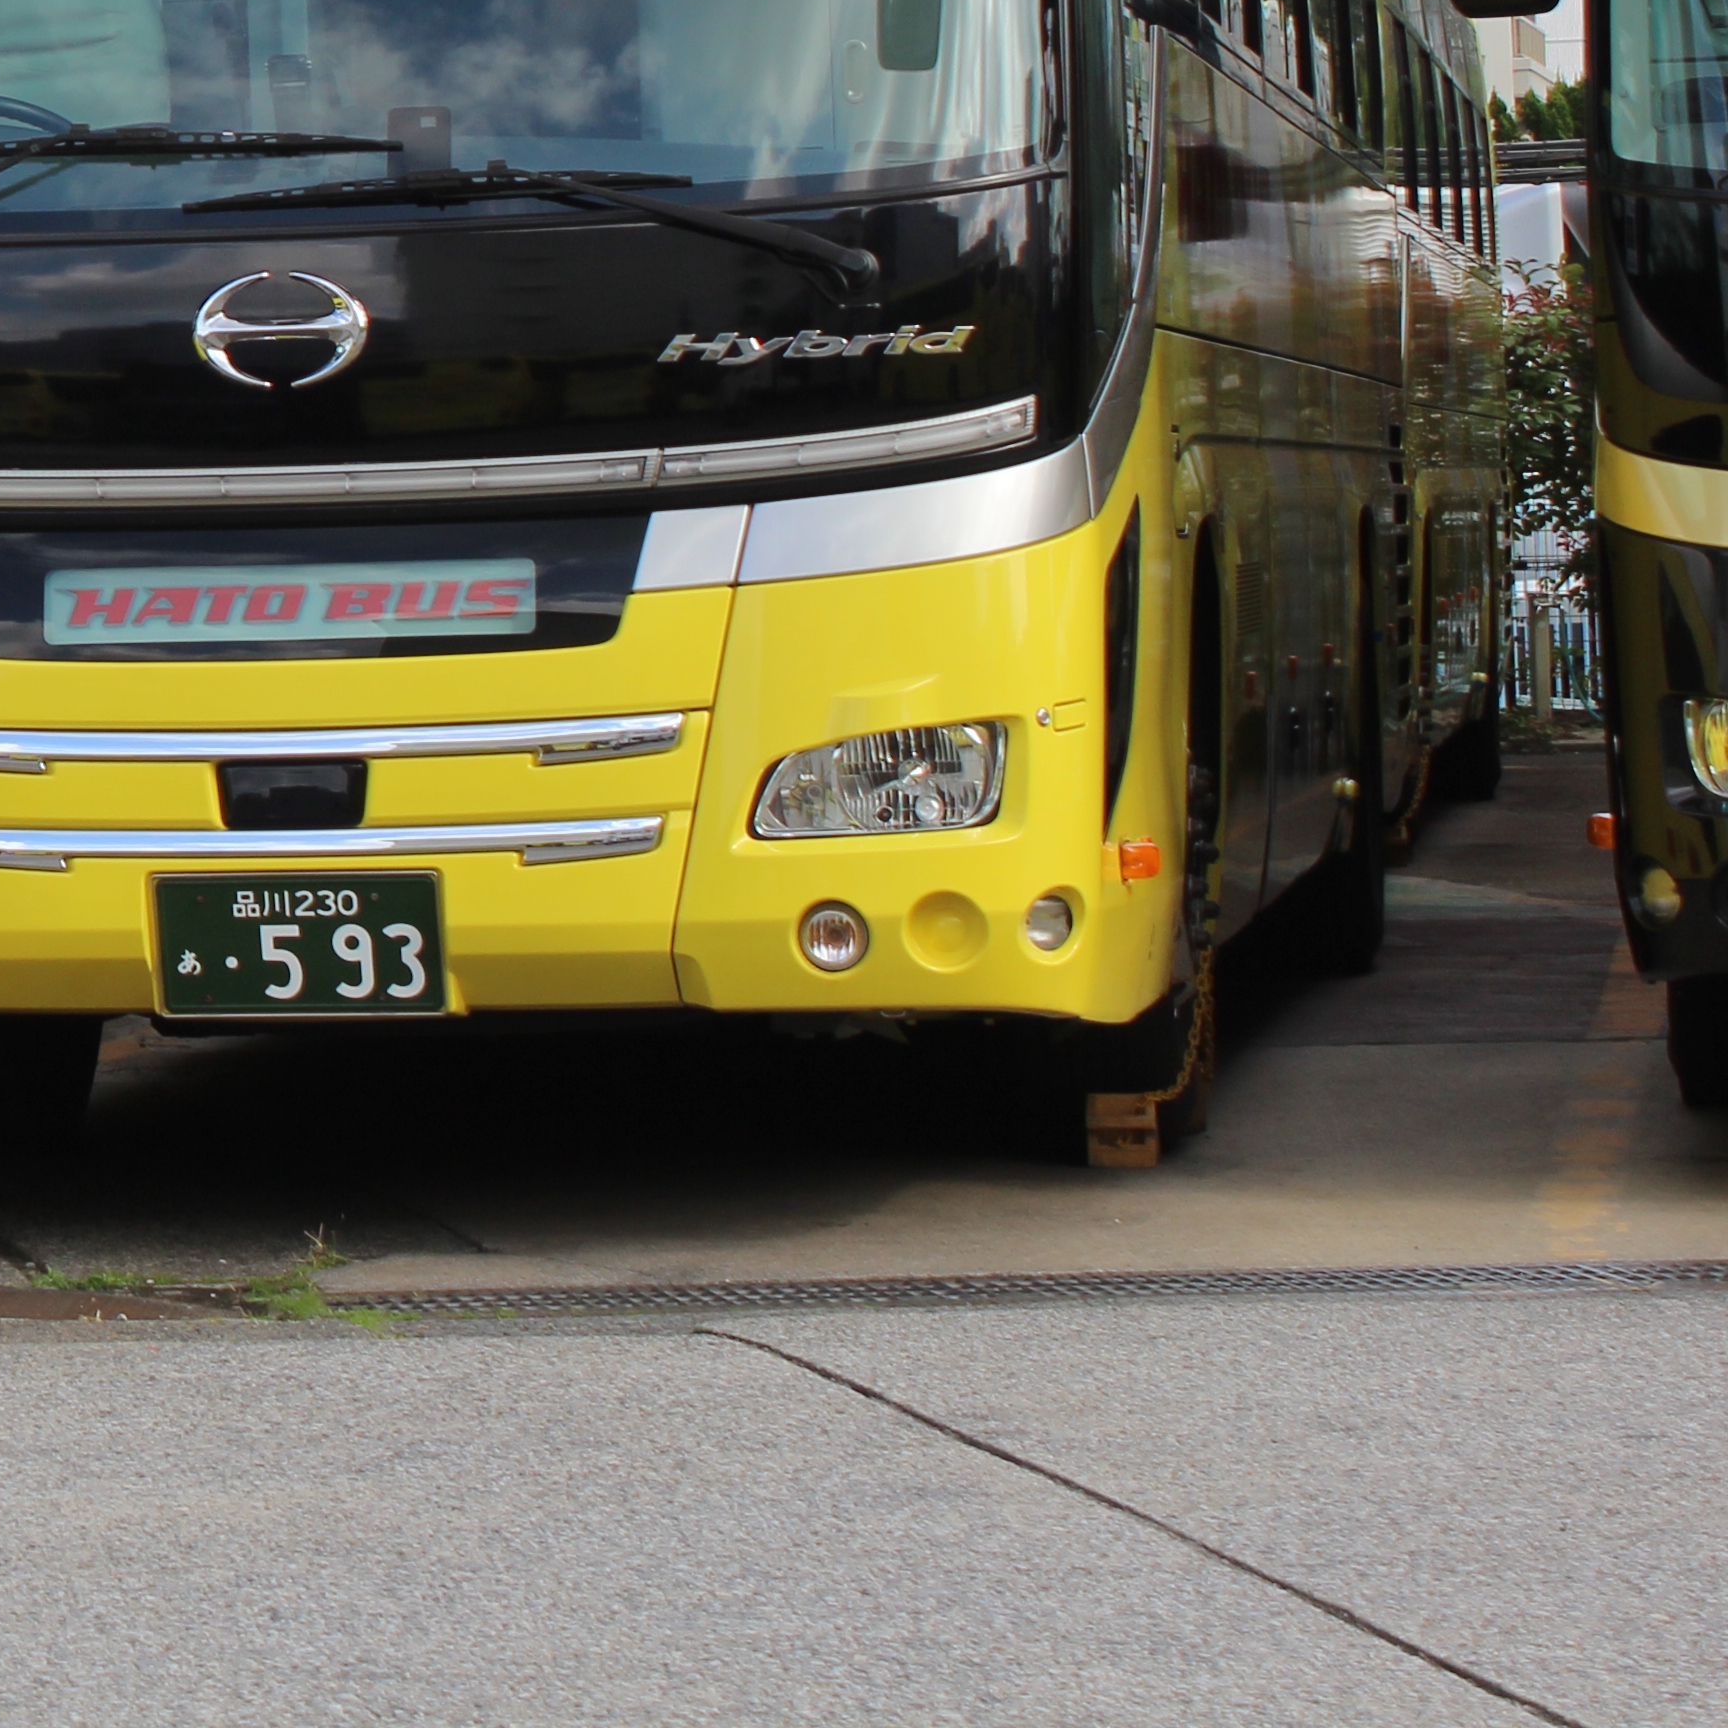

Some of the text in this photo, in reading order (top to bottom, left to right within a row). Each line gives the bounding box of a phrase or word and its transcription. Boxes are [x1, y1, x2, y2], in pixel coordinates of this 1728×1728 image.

[657, 324, 975, 366] Hybrid
[56, 579, 531, 627] HATO BUS
[177, 950, 201, 977] あ
